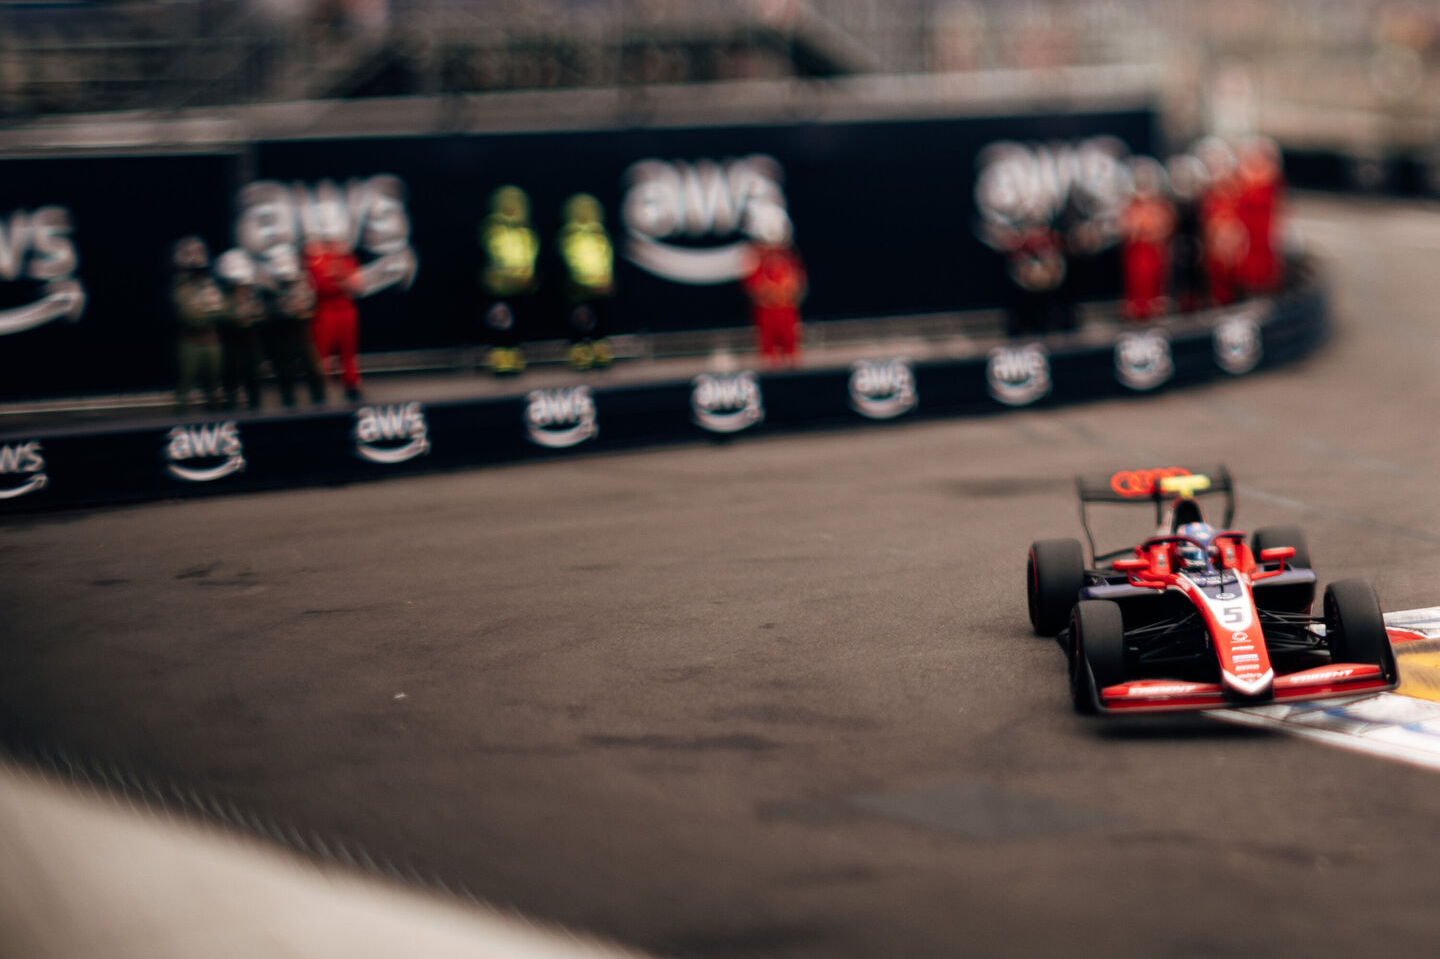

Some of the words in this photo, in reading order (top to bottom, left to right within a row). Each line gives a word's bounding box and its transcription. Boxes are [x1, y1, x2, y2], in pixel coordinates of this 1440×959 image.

[0, 206, 77, 280] ws
[166, 421, 243, 460] aws
[355, 403, 428, 441] aws
[0, 441, 44, 473] ws
[1223, 606, 1243, 623] 5
